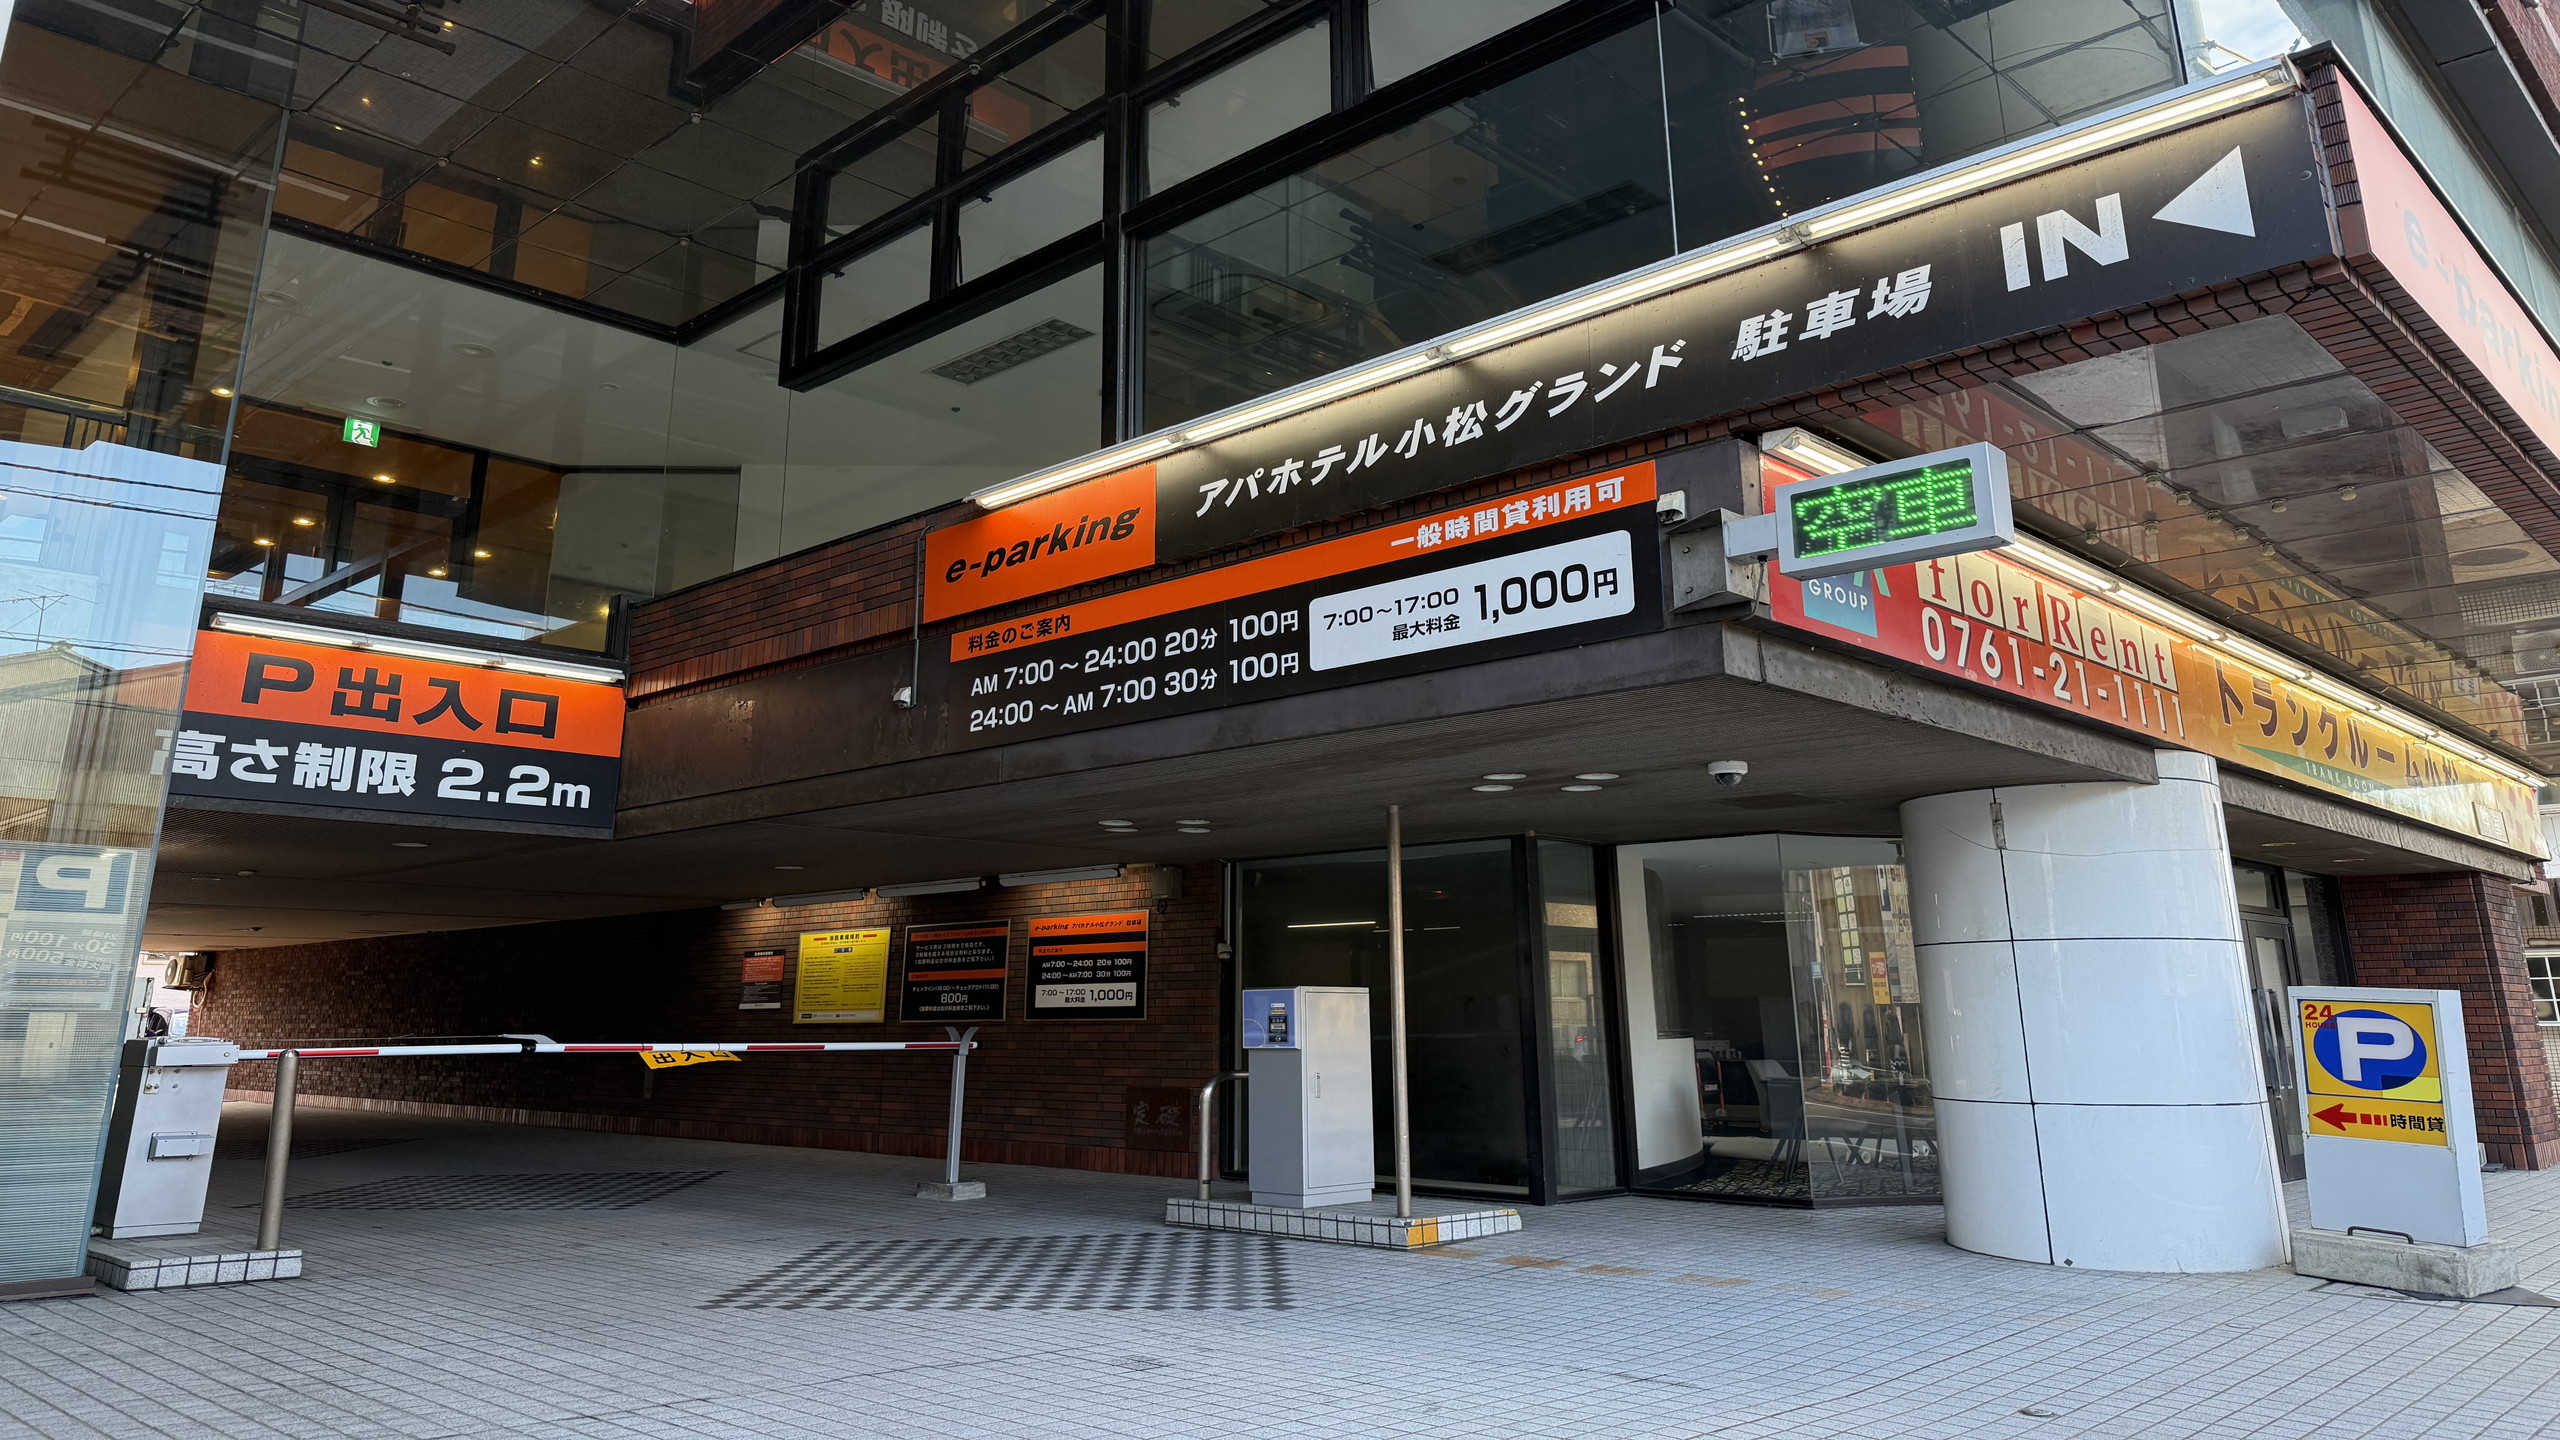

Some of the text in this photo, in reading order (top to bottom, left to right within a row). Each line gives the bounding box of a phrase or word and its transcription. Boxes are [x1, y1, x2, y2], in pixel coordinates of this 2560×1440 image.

[1195, 192, 2130, 518] アパホテル小松グランド 駐車場 IN
[945, 505, 1141, 584] e-parking
[1390, 475, 1626, 550] 一般時間貸利用可
[1796, 467, 1978, 558] 空車
[1473, 562, 1620, 625] 1,000円
[1808, 578, 1869, 611] GROUP
[967, 612, 1071, 653] 料金のご案内
[970, 674, 999, 696] AM
[1003, 658, 1054, 690] 7:00
[1084, 637, 1157, 675] 24:00
[1163, 626, 1218, 659] 20分
[1229, 610, 1299, 643] 100円
[1392, 612, 1461, 642] 最大料金
[2047, 594, 2168, 684] Rent
[241, 652, 561, 740] P 出入口
[969, 698, 1034, 733] 24:00
[1063, 690, 1095, 716] AM
[1101, 675, 1157, 708] 7:00
[1163, 666, 1218, 698] 30分
[1229, 651, 1300, 684] 100円
[1921, 607, 2186, 739] 0761-21-1111
[2215, 660, 2460, 787] トランクルーム小松
[160, 728, 592, 810] 高さ制限 2.2m
[2304, 761, 2341, 784] TRANK
[1034, 923, 1069, 931] e-parking
[1114, 958, 1132, 966] 100円
[940, 993, 968, 1003] 800円
[1090, 989, 1133, 1002] 1,000円
[2304, 1005, 2333, 1021] 24
[2305, 1021, 2336, 1029] HOURS
[2336, 1017, 2415, 1082] P
[2390, 1113, 2445, 1133] 時間貸
